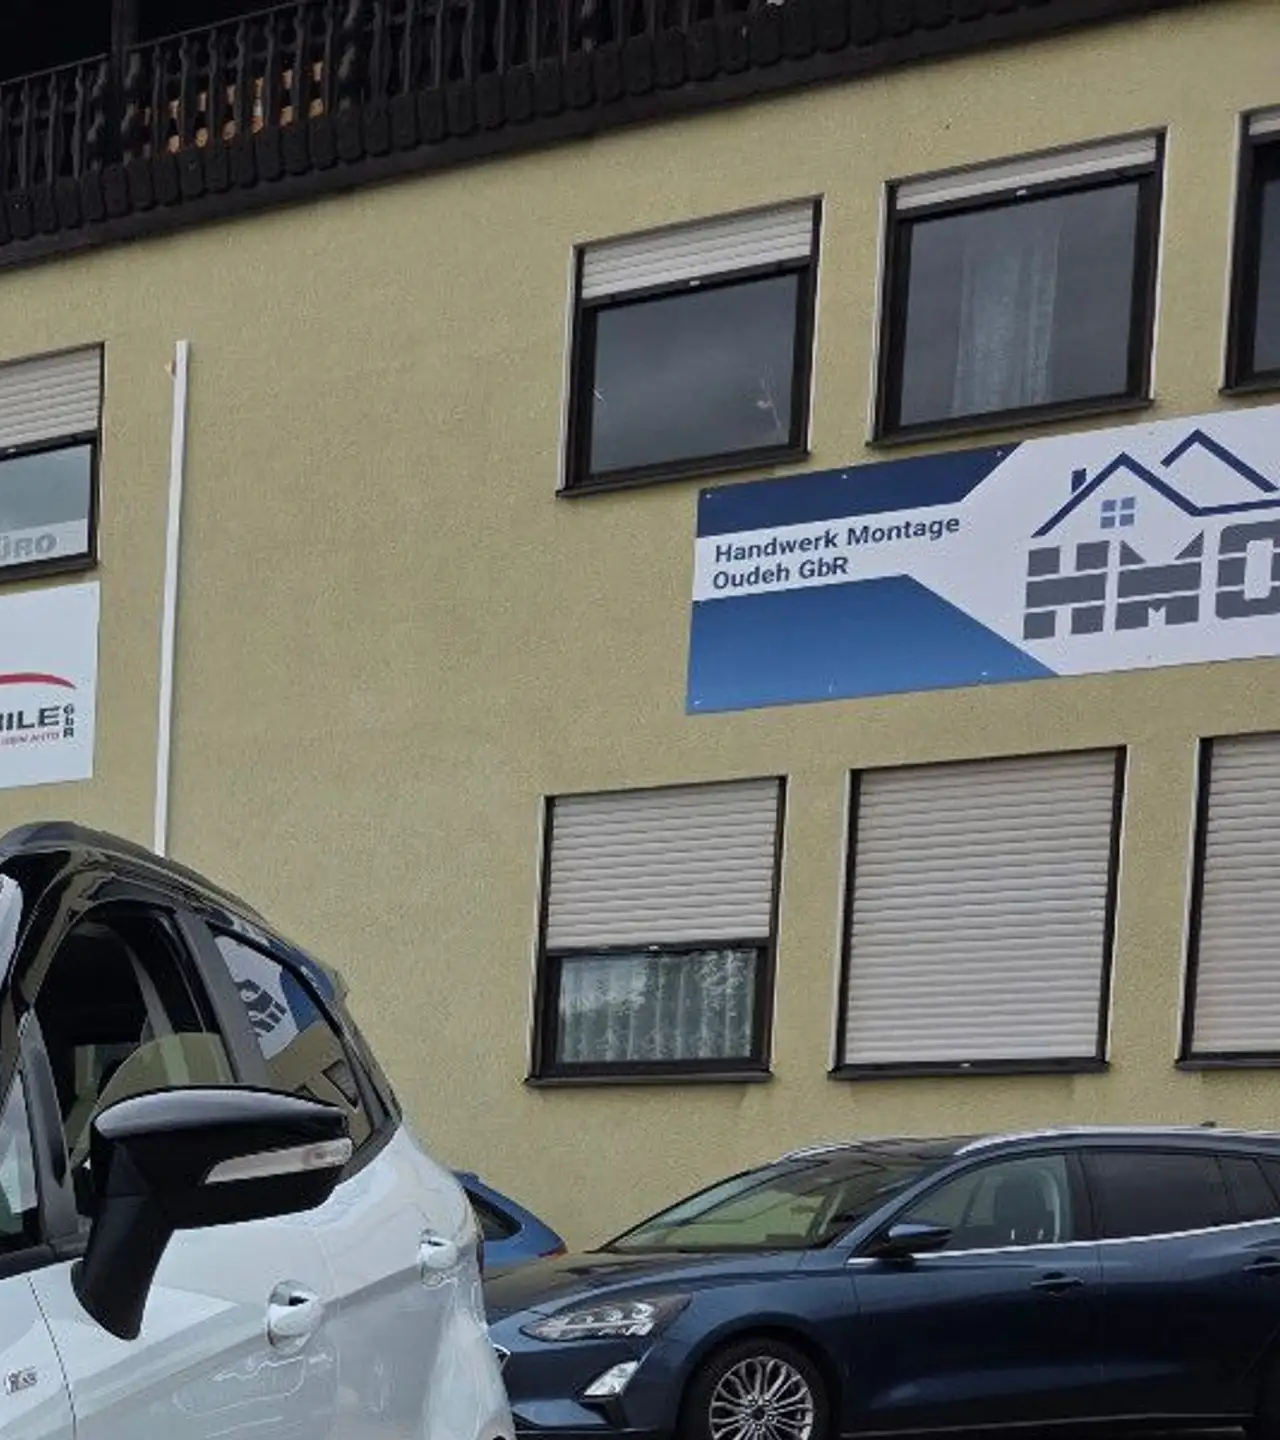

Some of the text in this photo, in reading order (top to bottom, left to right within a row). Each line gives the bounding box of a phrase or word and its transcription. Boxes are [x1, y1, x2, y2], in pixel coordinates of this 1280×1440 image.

[714, 515, 961, 563] Handwerk Montage
[712, 555, 850, 590] Oudeh GbR
